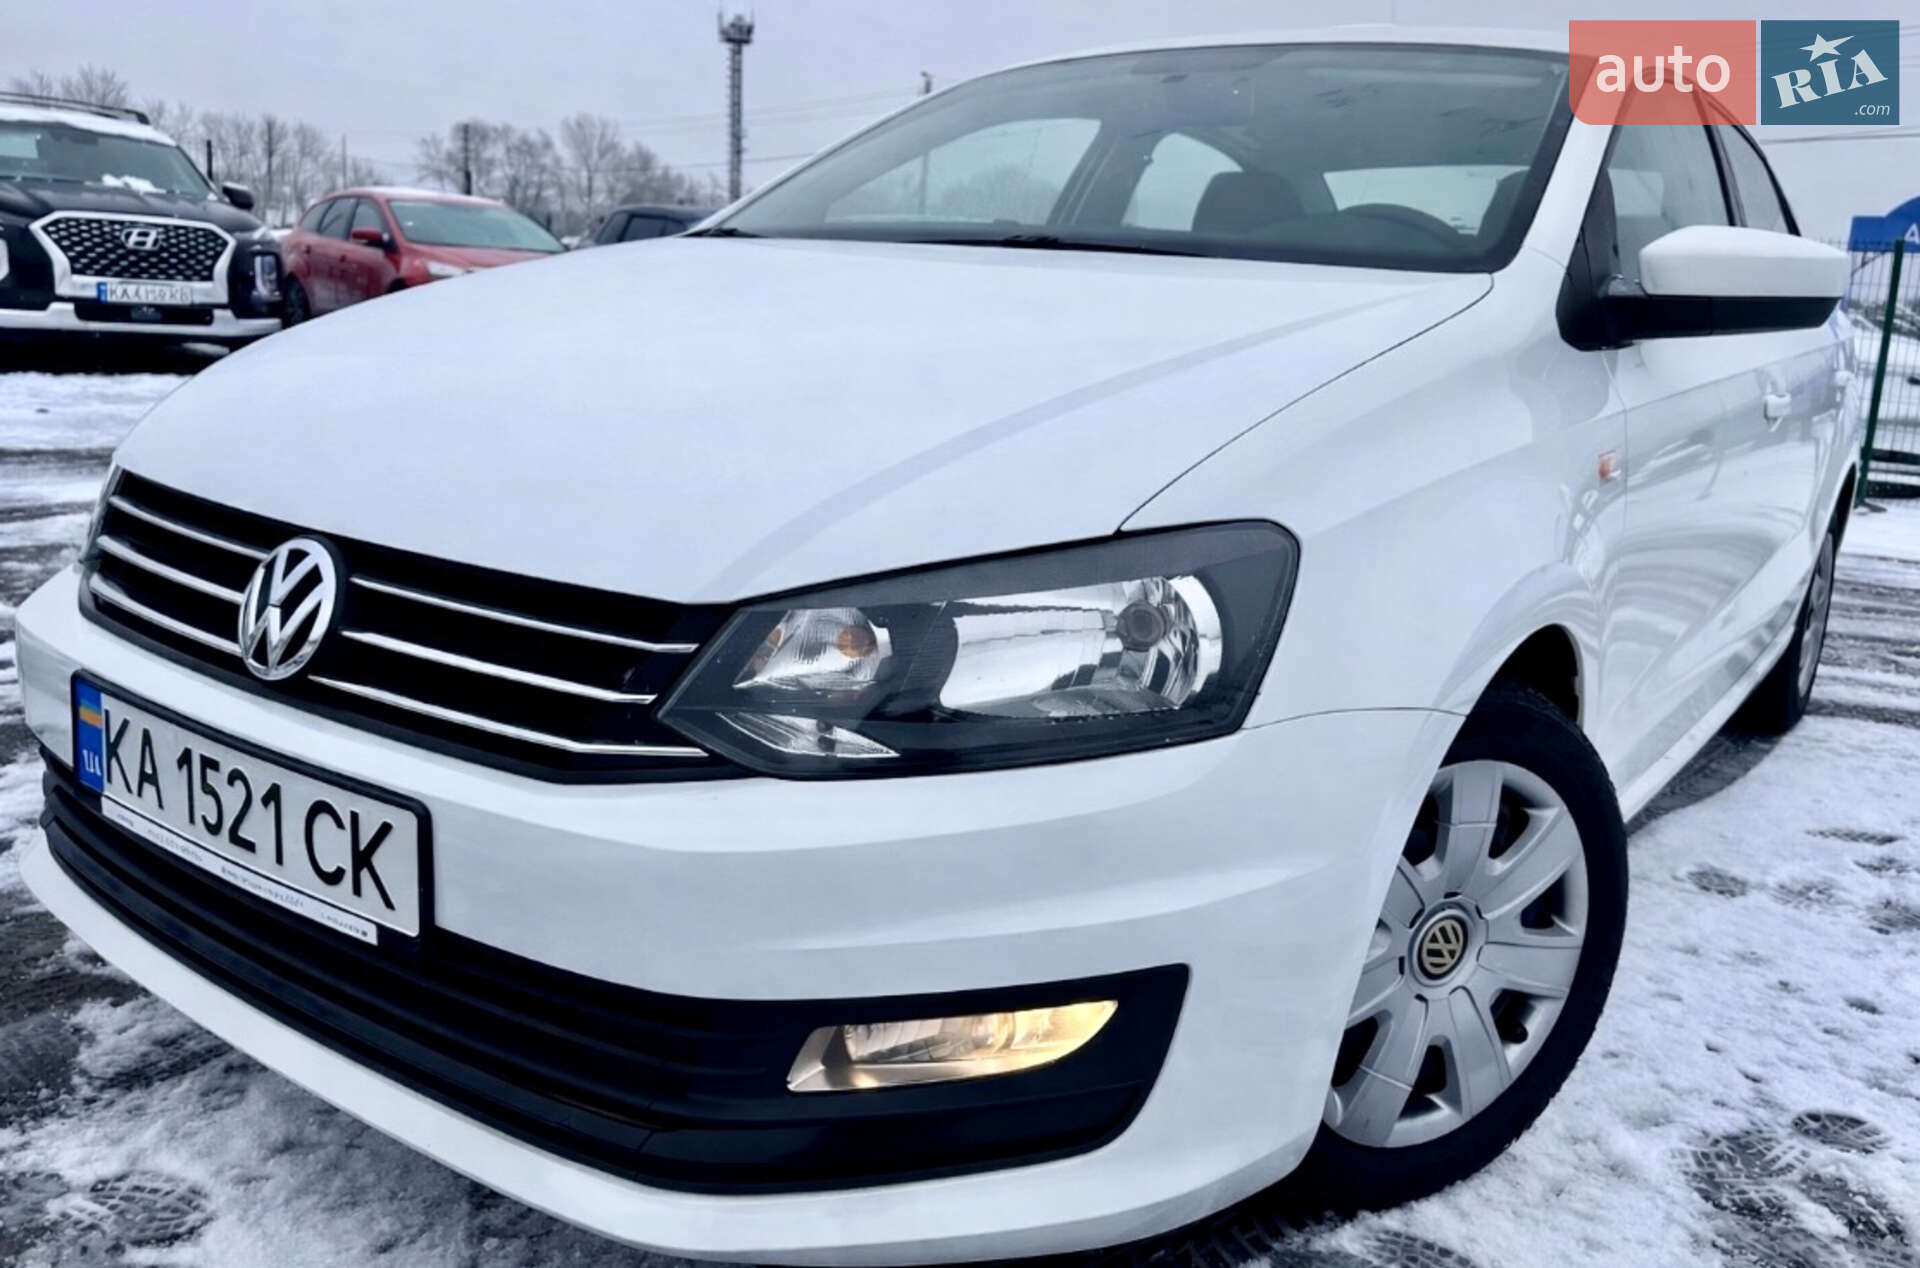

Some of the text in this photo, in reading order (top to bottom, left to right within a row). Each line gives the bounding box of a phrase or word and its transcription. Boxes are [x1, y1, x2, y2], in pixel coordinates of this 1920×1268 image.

[104, 709, 396, 911] KA 1521 CK
